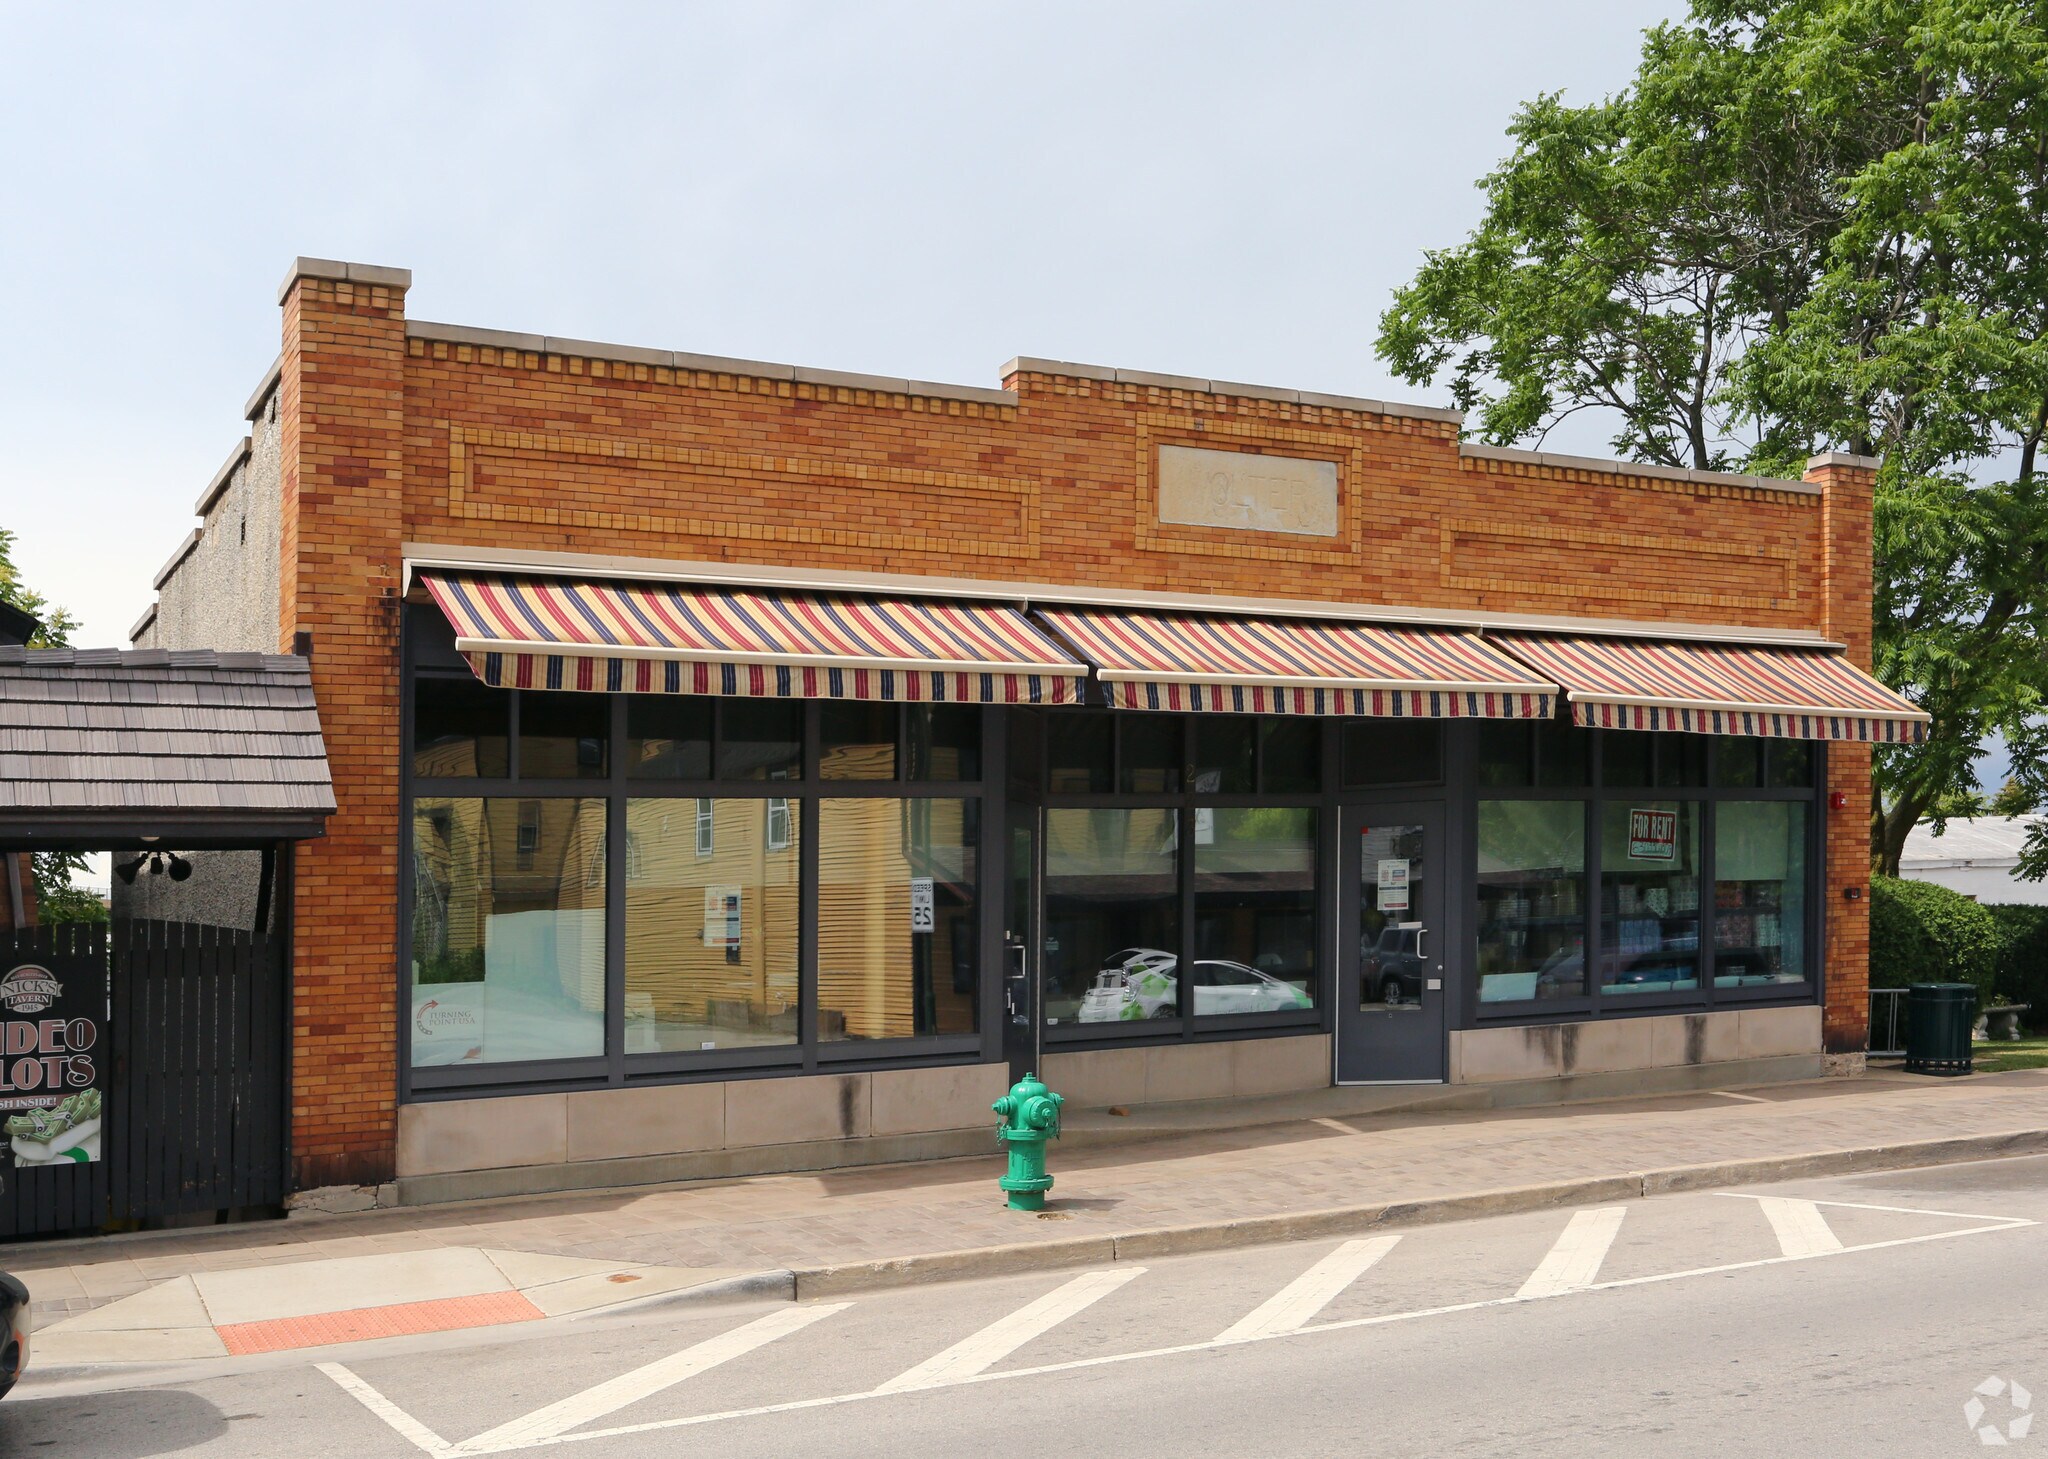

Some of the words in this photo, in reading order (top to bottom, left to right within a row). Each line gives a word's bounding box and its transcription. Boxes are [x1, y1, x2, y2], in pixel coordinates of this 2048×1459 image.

[1633, 814, 1649, 839] FOR
[1651, 815, 1673, 840] RENT
[1, 980, 57, 997] NICK'S
[9, 994, 49, 1005] TAVERN
[430, 1010, 472, 1019] TURNING
[16, 1097, 57, 1108] INSIDE!
